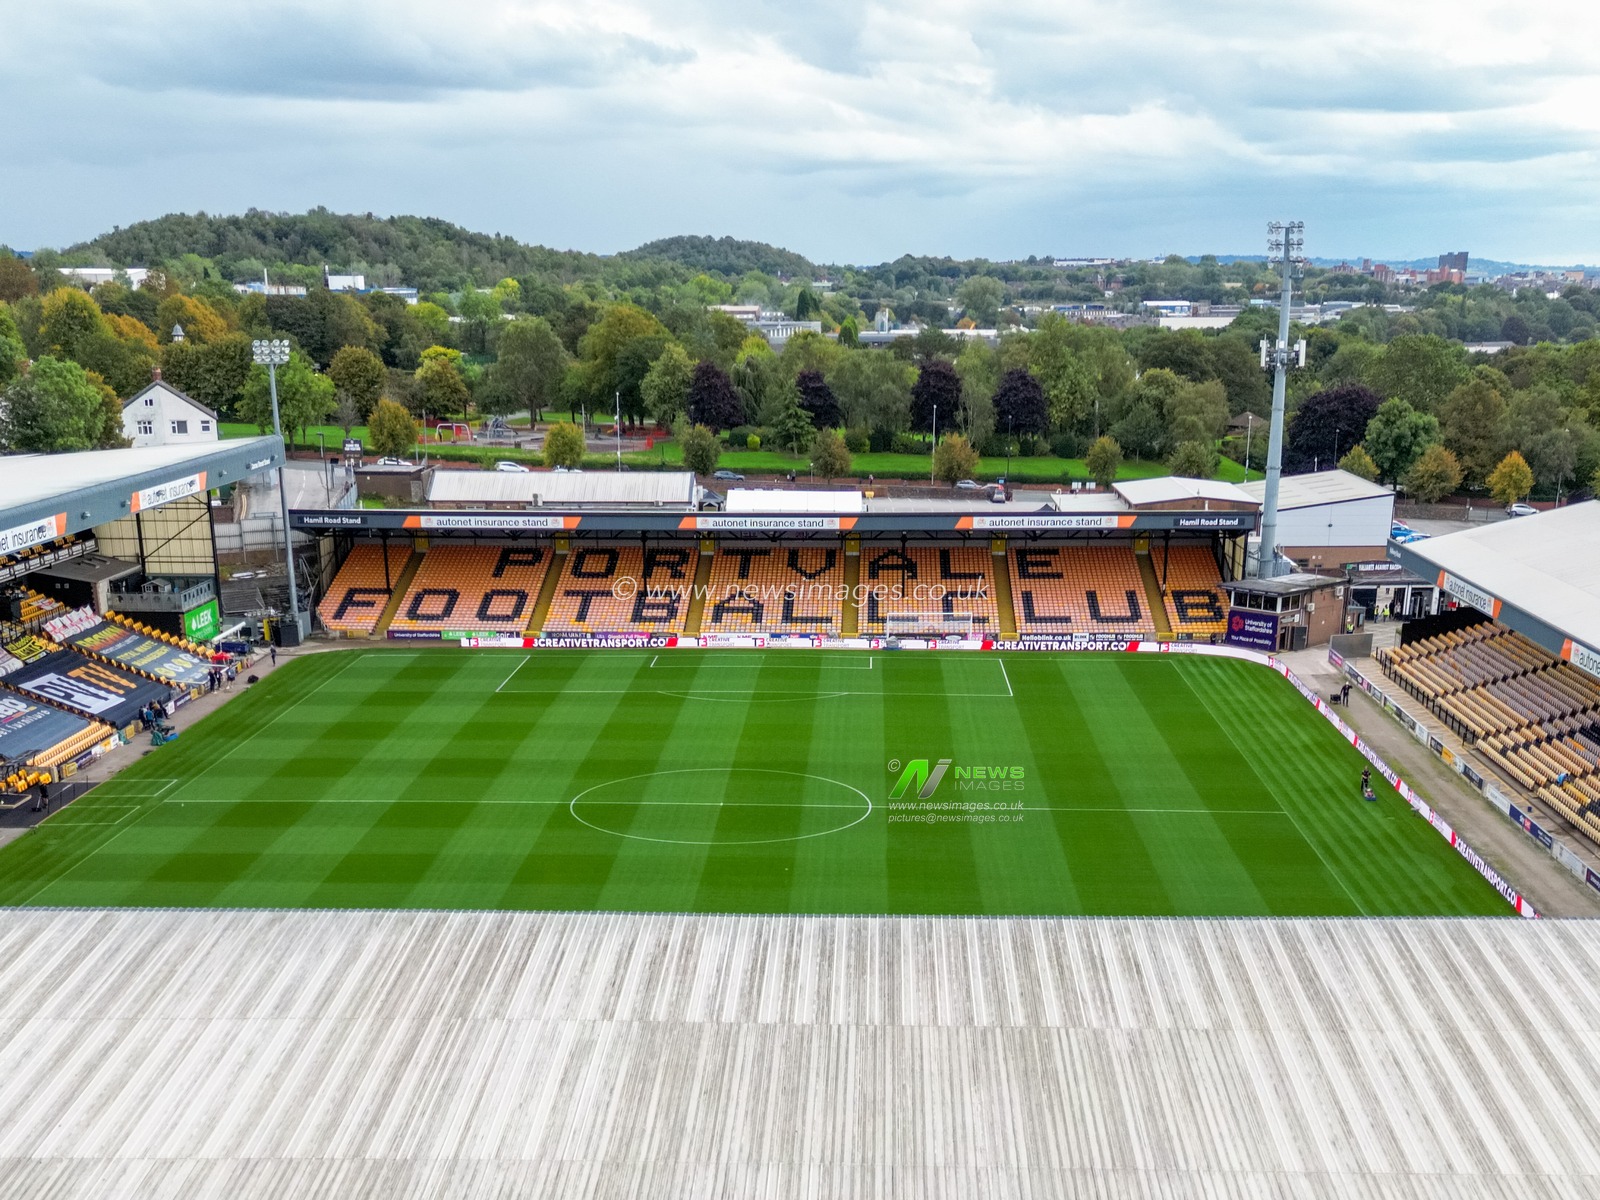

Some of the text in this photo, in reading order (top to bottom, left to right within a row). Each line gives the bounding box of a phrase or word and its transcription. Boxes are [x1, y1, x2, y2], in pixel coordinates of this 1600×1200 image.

[303, 516, 361, 525] Hamil Road Stand
[436, 517, 549, 527] autonet insurance stand
[712, 518, 824, 528] autonet insurance stand
[988, 517, 1102, 527] autonet insurance stand
[1179, 517, 1239, 526] Hamil Road Stand
[1448, 578, 1487, 611] autonet insurance
[1244, 618, 1266, 628] University
[1244, 625, 1273, 634] Staffordshire
